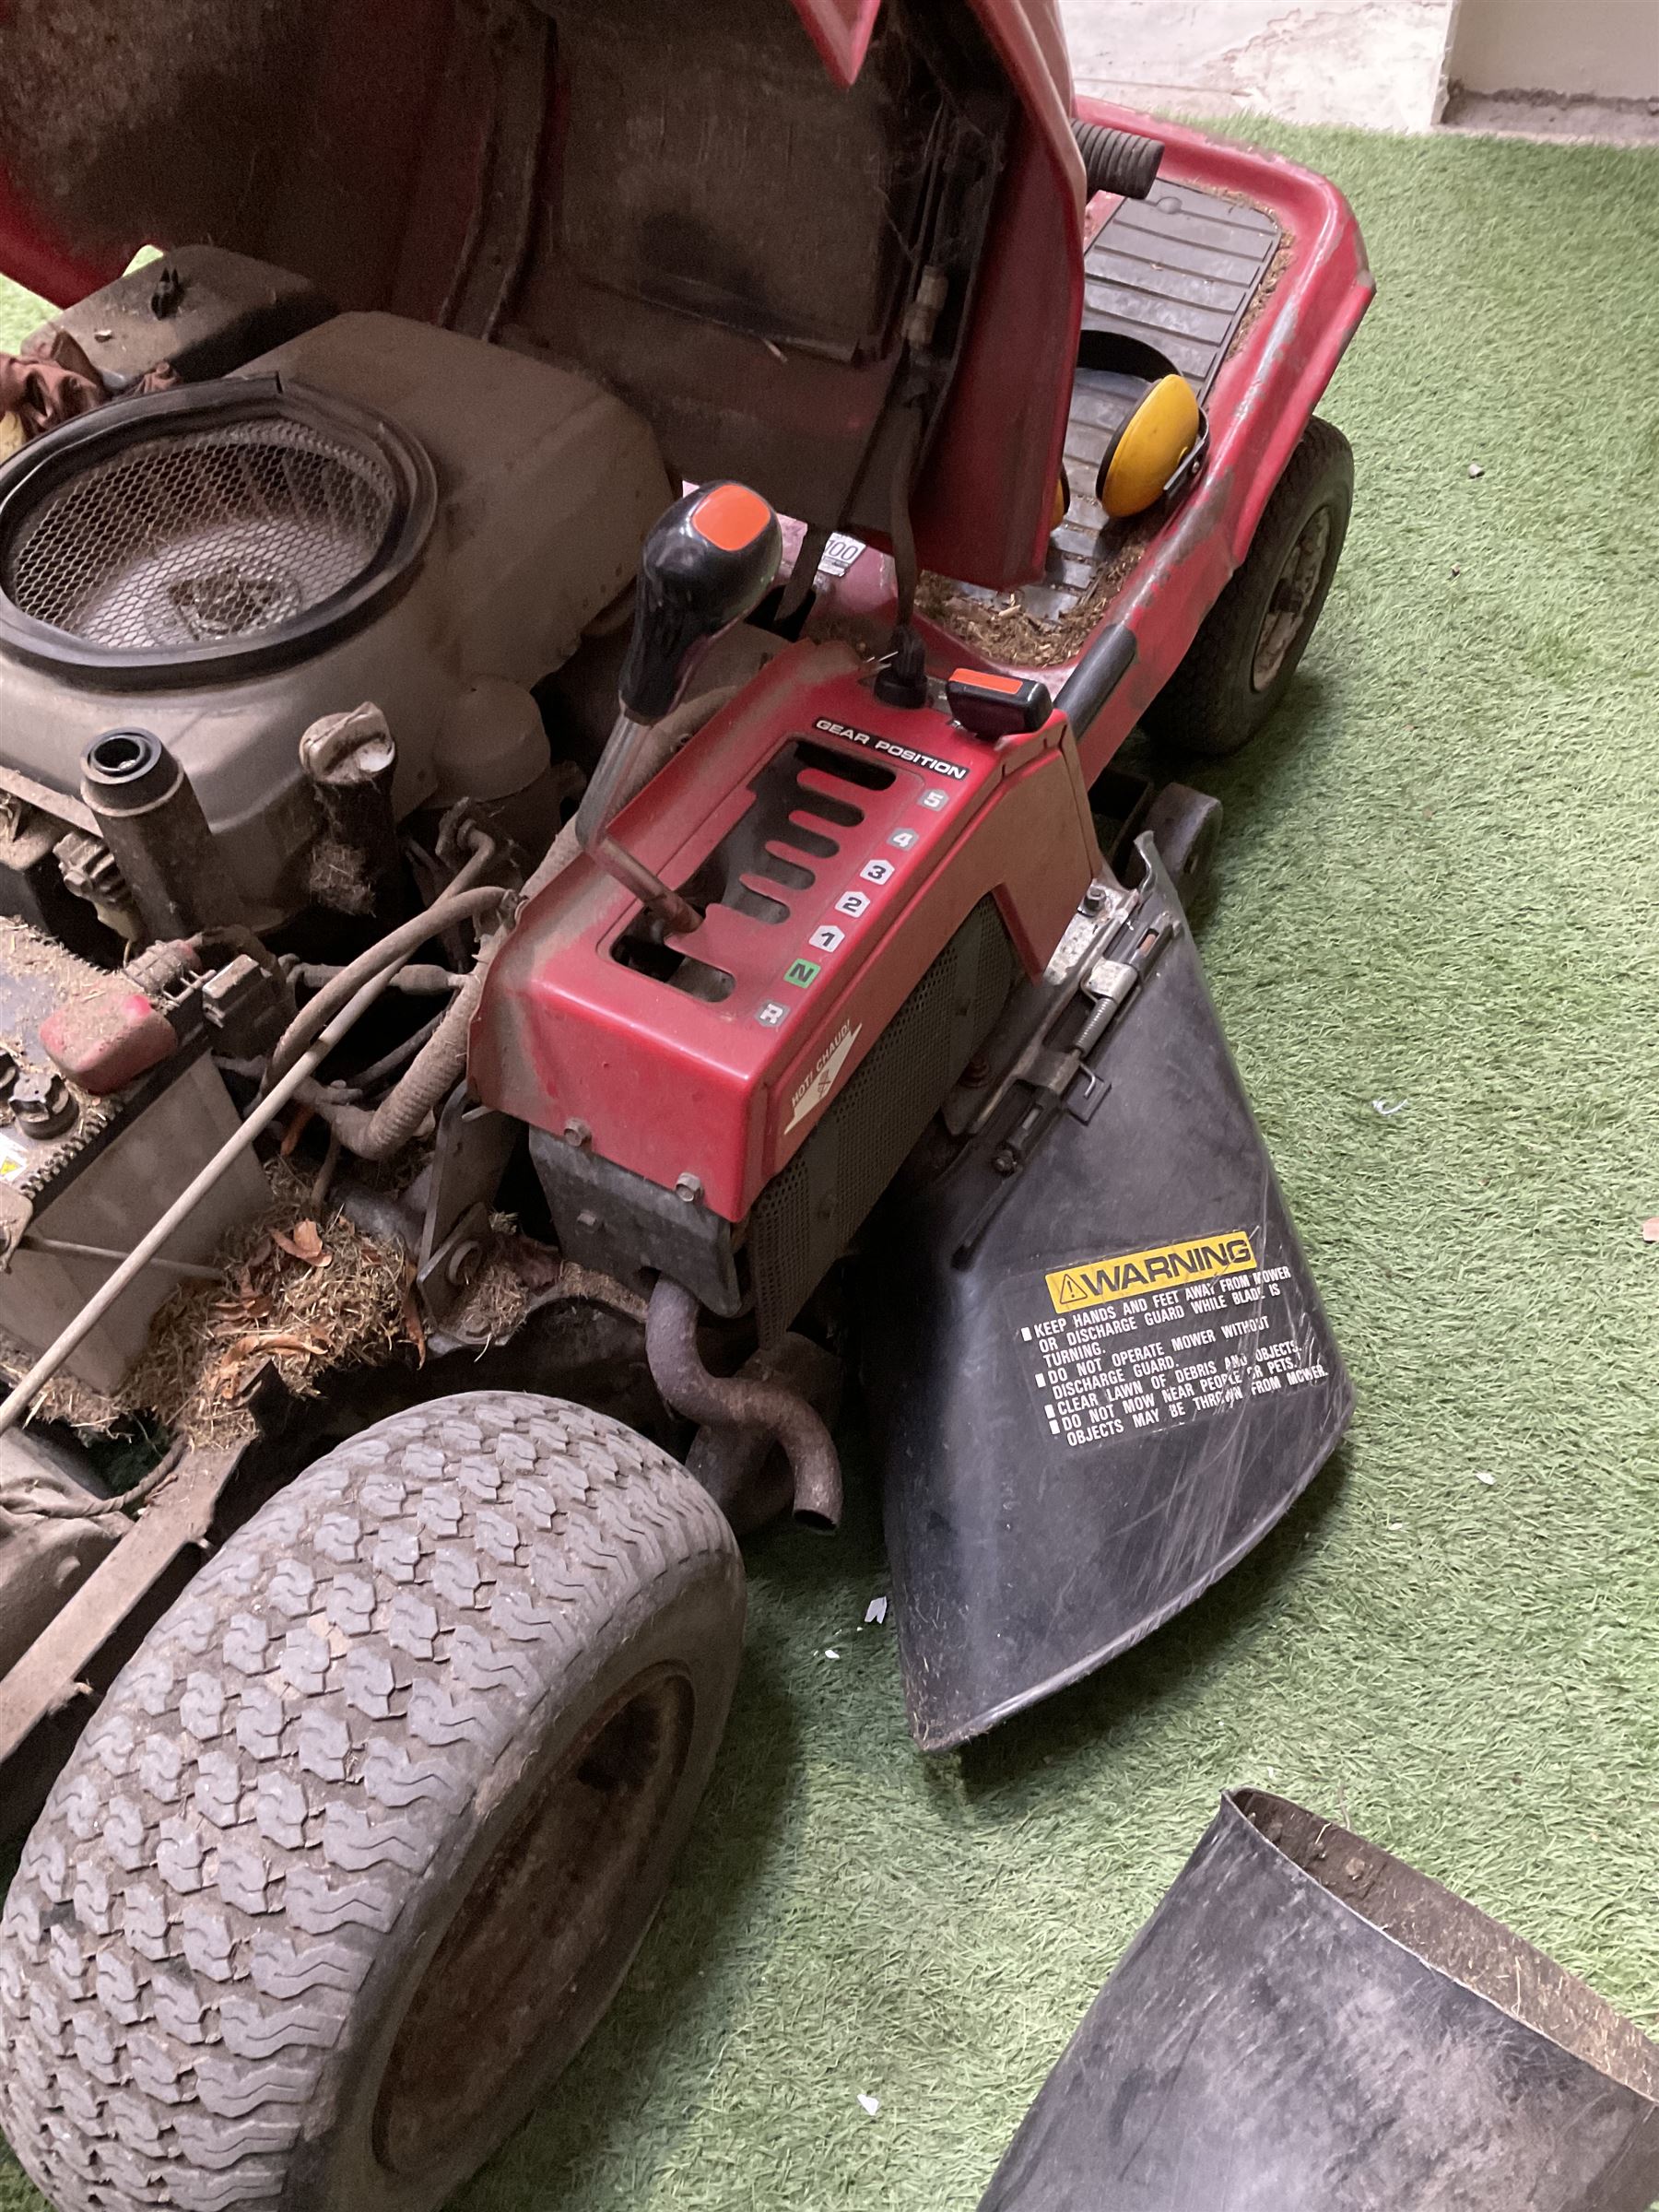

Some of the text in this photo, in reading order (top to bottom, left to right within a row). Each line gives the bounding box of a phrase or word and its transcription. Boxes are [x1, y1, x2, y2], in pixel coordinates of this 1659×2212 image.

[817, 719, 967, 779] GEAR POSITION
[924, 792, 941, 808] 5
[893, 831, 912, 847] 4
[867, 865, 887, 881] 3
[842, 897, 863, 913] 2
[820, 932, 835, 947] 1
[790, 962, 815, 984] N
[759, 1004, 784, 1025] R
[792, 1018, 850, 1107] HOT! CHAUD!
[1080, 1239, 1252, 1296] WARNING
[1034, 1265, 1291, 1337] KEEP HANDS AND FEET AWAY FROM MOWER
[1039, 1337, 1058, 1353] OR
[1066, 1316, 1137, 1346] DISCHARGE
[1144, 1305, 1184, 1326] GUARD
[1191, 1295, 1228, 1314] WHILE
[1268, 1283, 1280, 1297] IS
[1043, 1342, 1106, 1368] TURNING.
[1048, 1316, 1270, 1384] DO NOT OPERATE MOWER WITHOUT
[1053, 1356, 1179, 1400] DISCHARGE GUARD.
[1057, 1340, 1302, 1415] CLEAR LAWN OF DEBRIS AND OBJECTS.
[1062, 1414, 1082, 1430] DO
[1088, 1404, 1115, 1424] NOT
[1123, 1393, 1155, 1414] MOW
[1161, 1383, 1194, 1403] NEAR
[1200, 1370, 1242, 1393] PEOPLE
[1267, 1357, 1298, 1374] PETS.
[1066, 1418, 1124, 1447] OBJECTS
[1132, 1408, 1160, 1428] MAY
[1168, 1401, 1186, 1418] BE
[1193, 1386, 1243, 1411] THROWN
[1251, 1375, 1282, 1395] FROM
